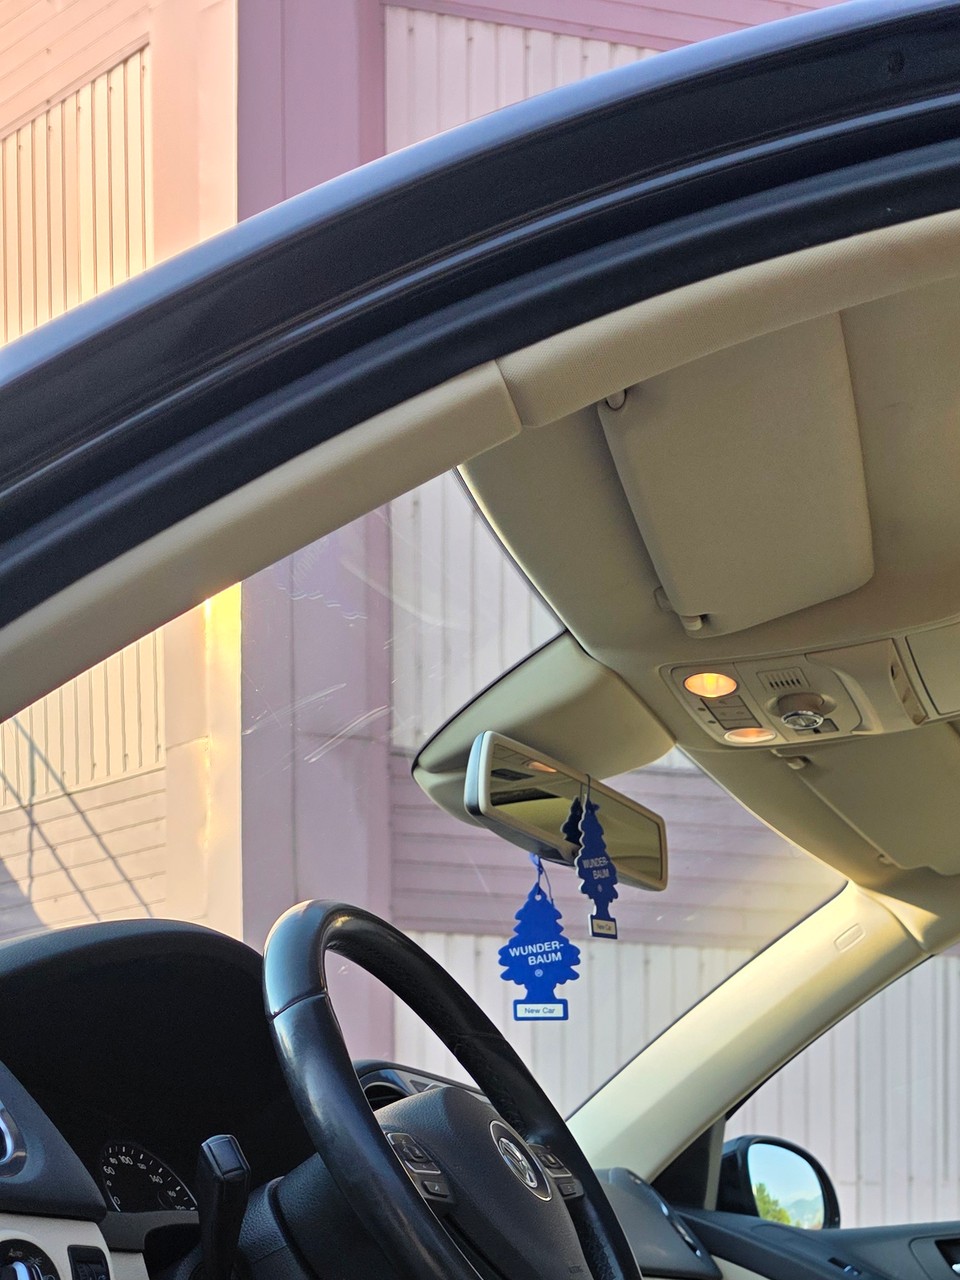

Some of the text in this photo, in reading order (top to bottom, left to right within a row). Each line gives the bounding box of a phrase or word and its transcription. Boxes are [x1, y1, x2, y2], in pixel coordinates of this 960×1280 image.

[592, 868, 610, 880] BAUM
[508, 940, 564, 957] WUNDER-
[527, 951, 562, 966] BAUM
[118, 1155, 133, 1165] 100
